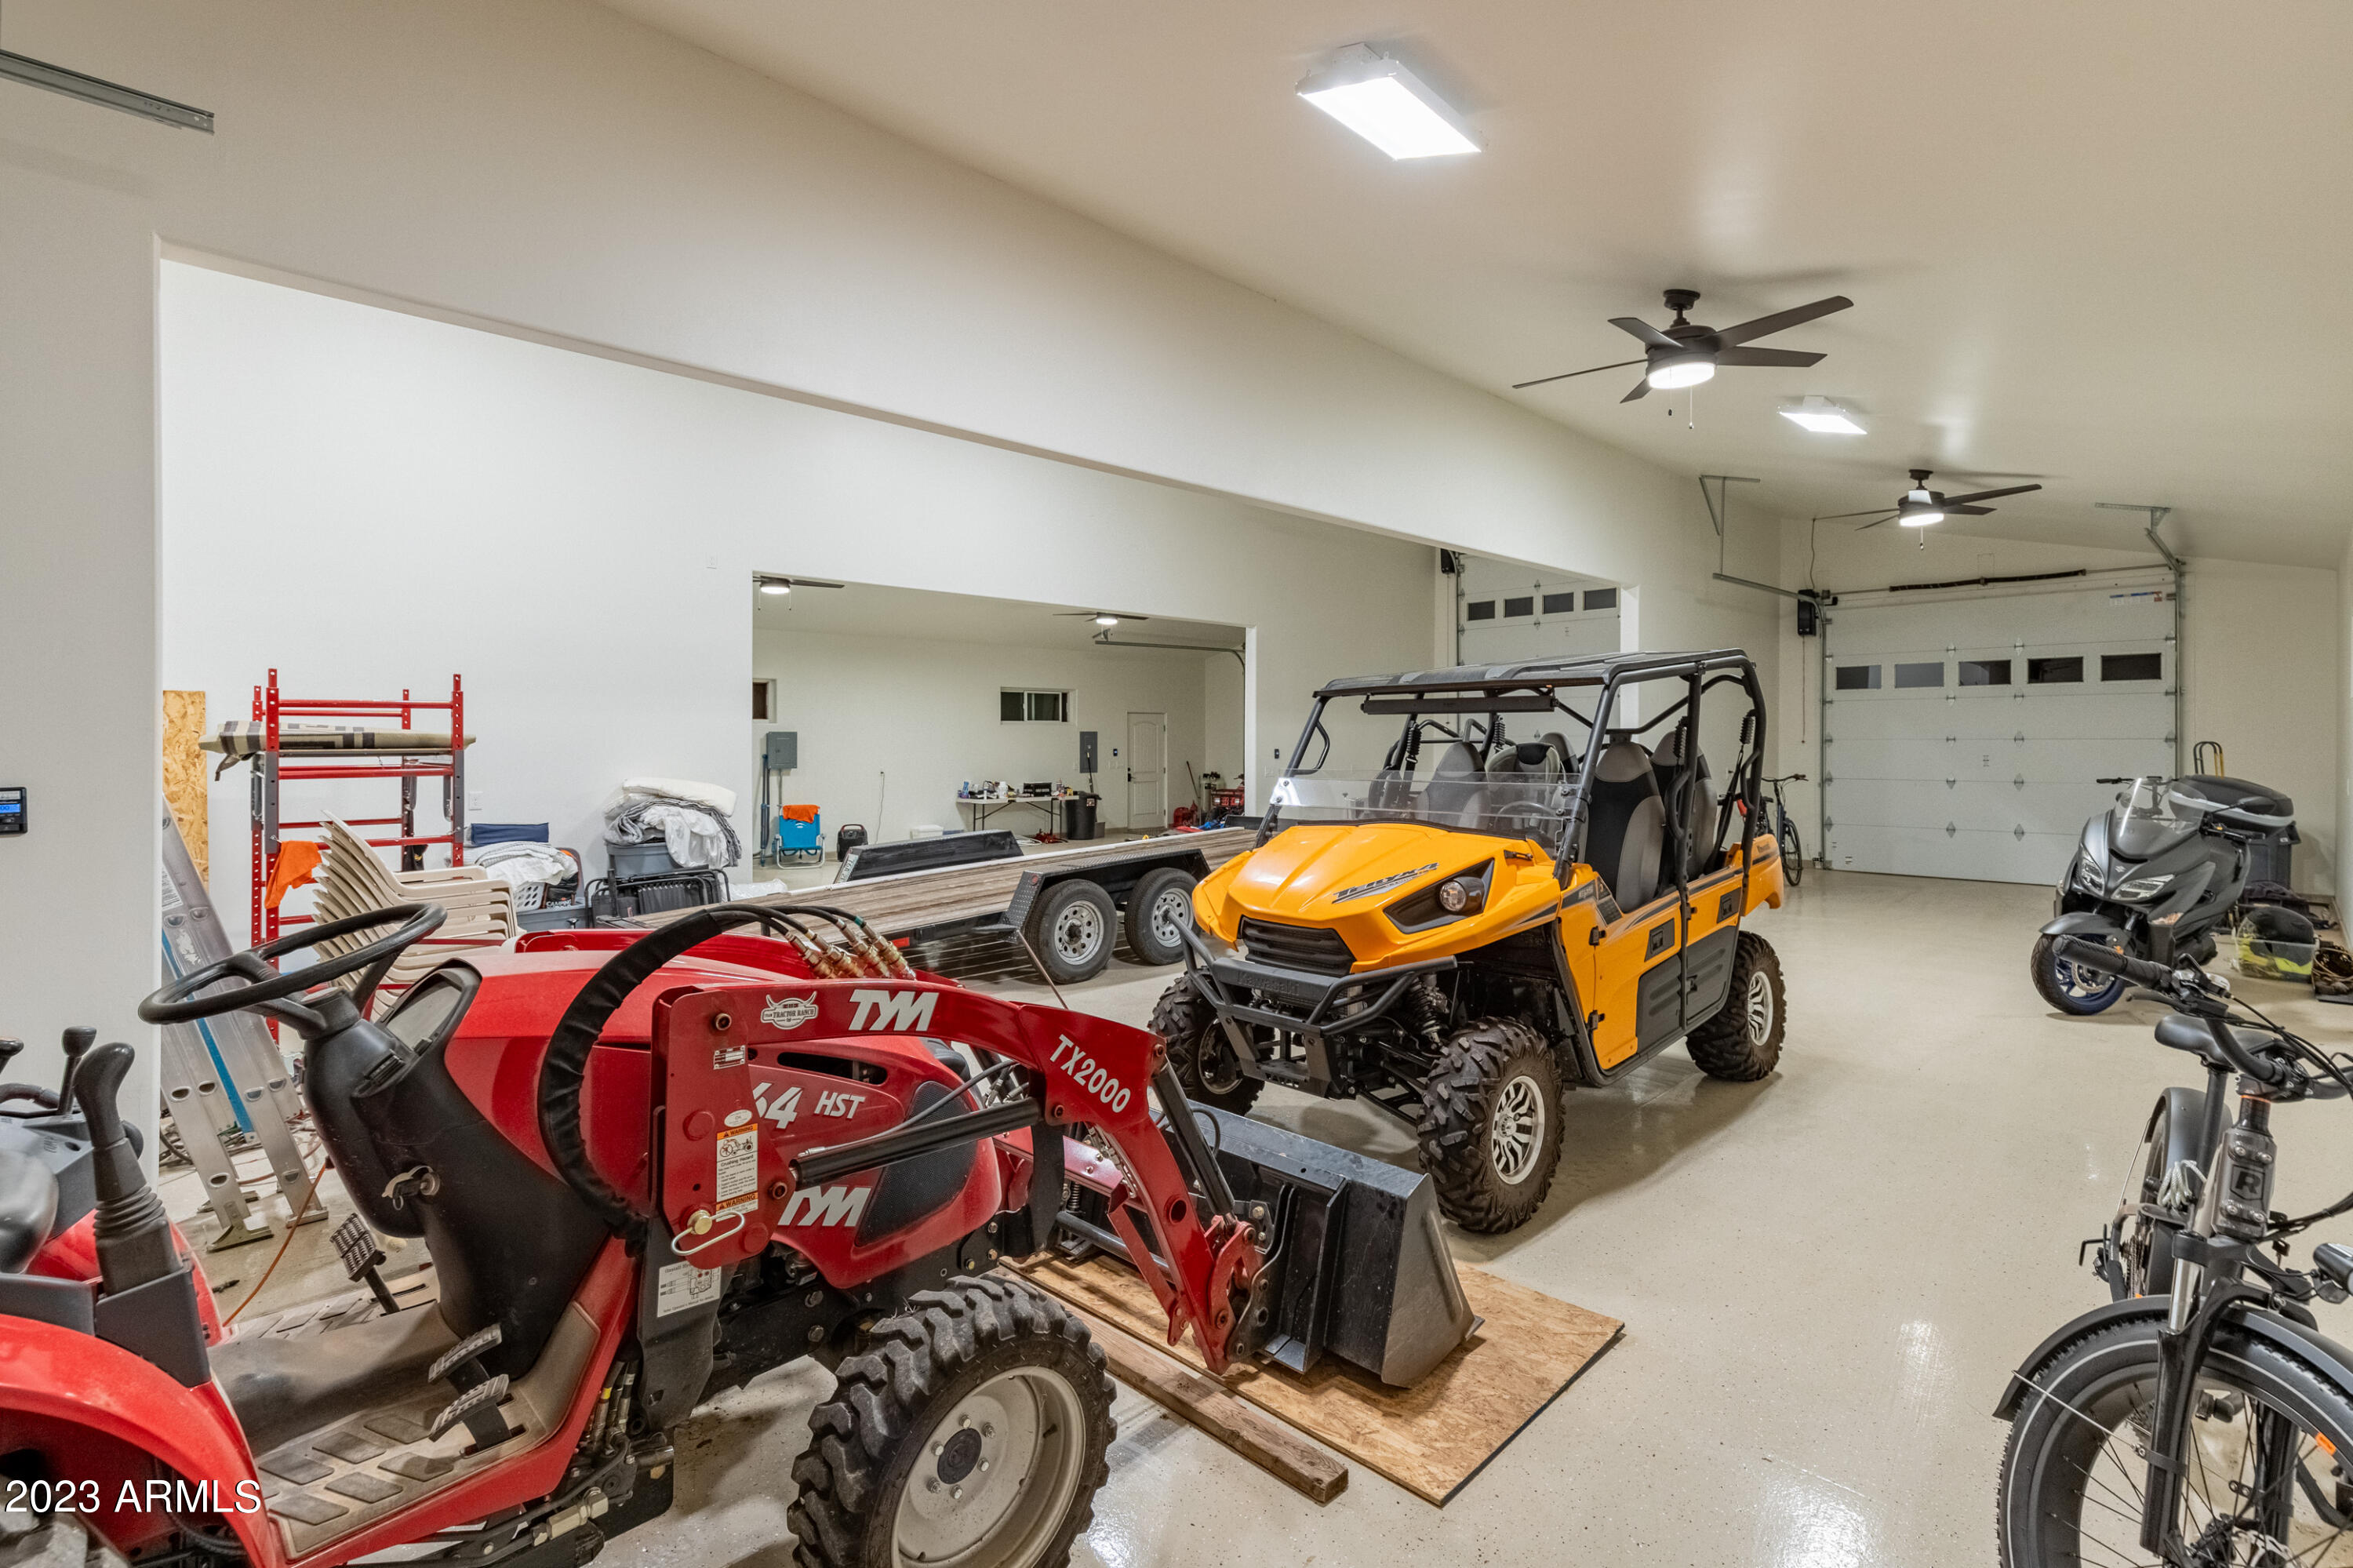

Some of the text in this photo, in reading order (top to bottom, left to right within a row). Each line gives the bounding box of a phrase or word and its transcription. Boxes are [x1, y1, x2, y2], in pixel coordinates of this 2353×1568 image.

[1238, 971, 1299, 996] Kawasaki
[848, 988, 940, 1031] TYM
[1049, 1034, 1131, 1113] TX2000
[813, 1090, 867, 1119] HST
[726, 1193, 755, 1207] WARNING
[777, 1185, 872, 1228] TYM
